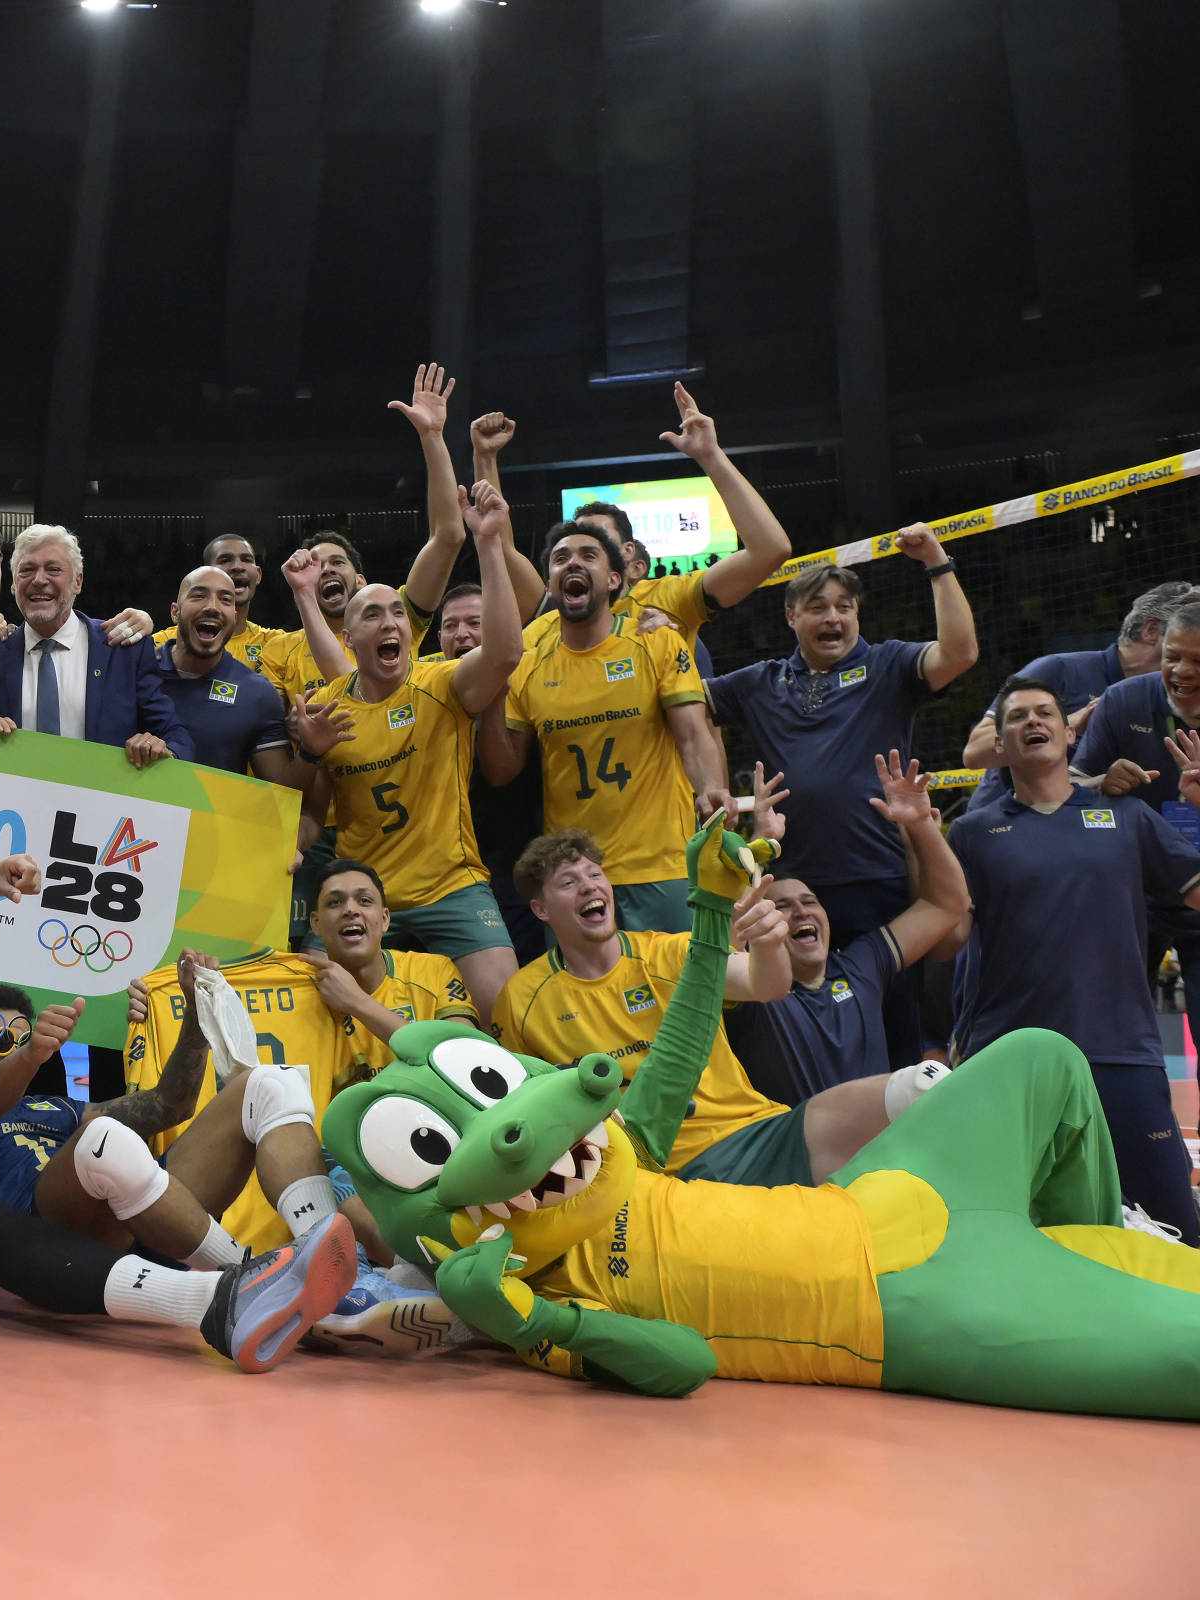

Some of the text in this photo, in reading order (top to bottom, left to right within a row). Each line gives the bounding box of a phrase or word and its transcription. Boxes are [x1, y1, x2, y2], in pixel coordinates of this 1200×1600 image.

[1063, 465, 1175, 505] BANCO DO BRASIL
[679, 522, 699, 532] 28
[948, 514, 987, 533] BRASIL
[784, 564, 798, 576] DO
[608, 672, 634, 682] BRASIL
[390, 719, 414, 728] BRASIL
[556, 707, 642, 730] BANCO DO BRASIL
[1130, 724, 1152, 734] VOLT
[346, 762, 376, 776] BANCO
[376, 758, 390, 769] DO
[568, 737, 632, 800] 14
[942, 774, 977, 786] BANCO
[371, 782, 410, 834] 5
[988, 825, 1013, 835] VOLT
[49, 810, 158, 873] LA
[40, 861, 144, 923] 28
[170, 988, 295, 1020] BETO
[628, 999, 656, 1014] BRASIL
[611, 1208, 628, 1252] BANCO
